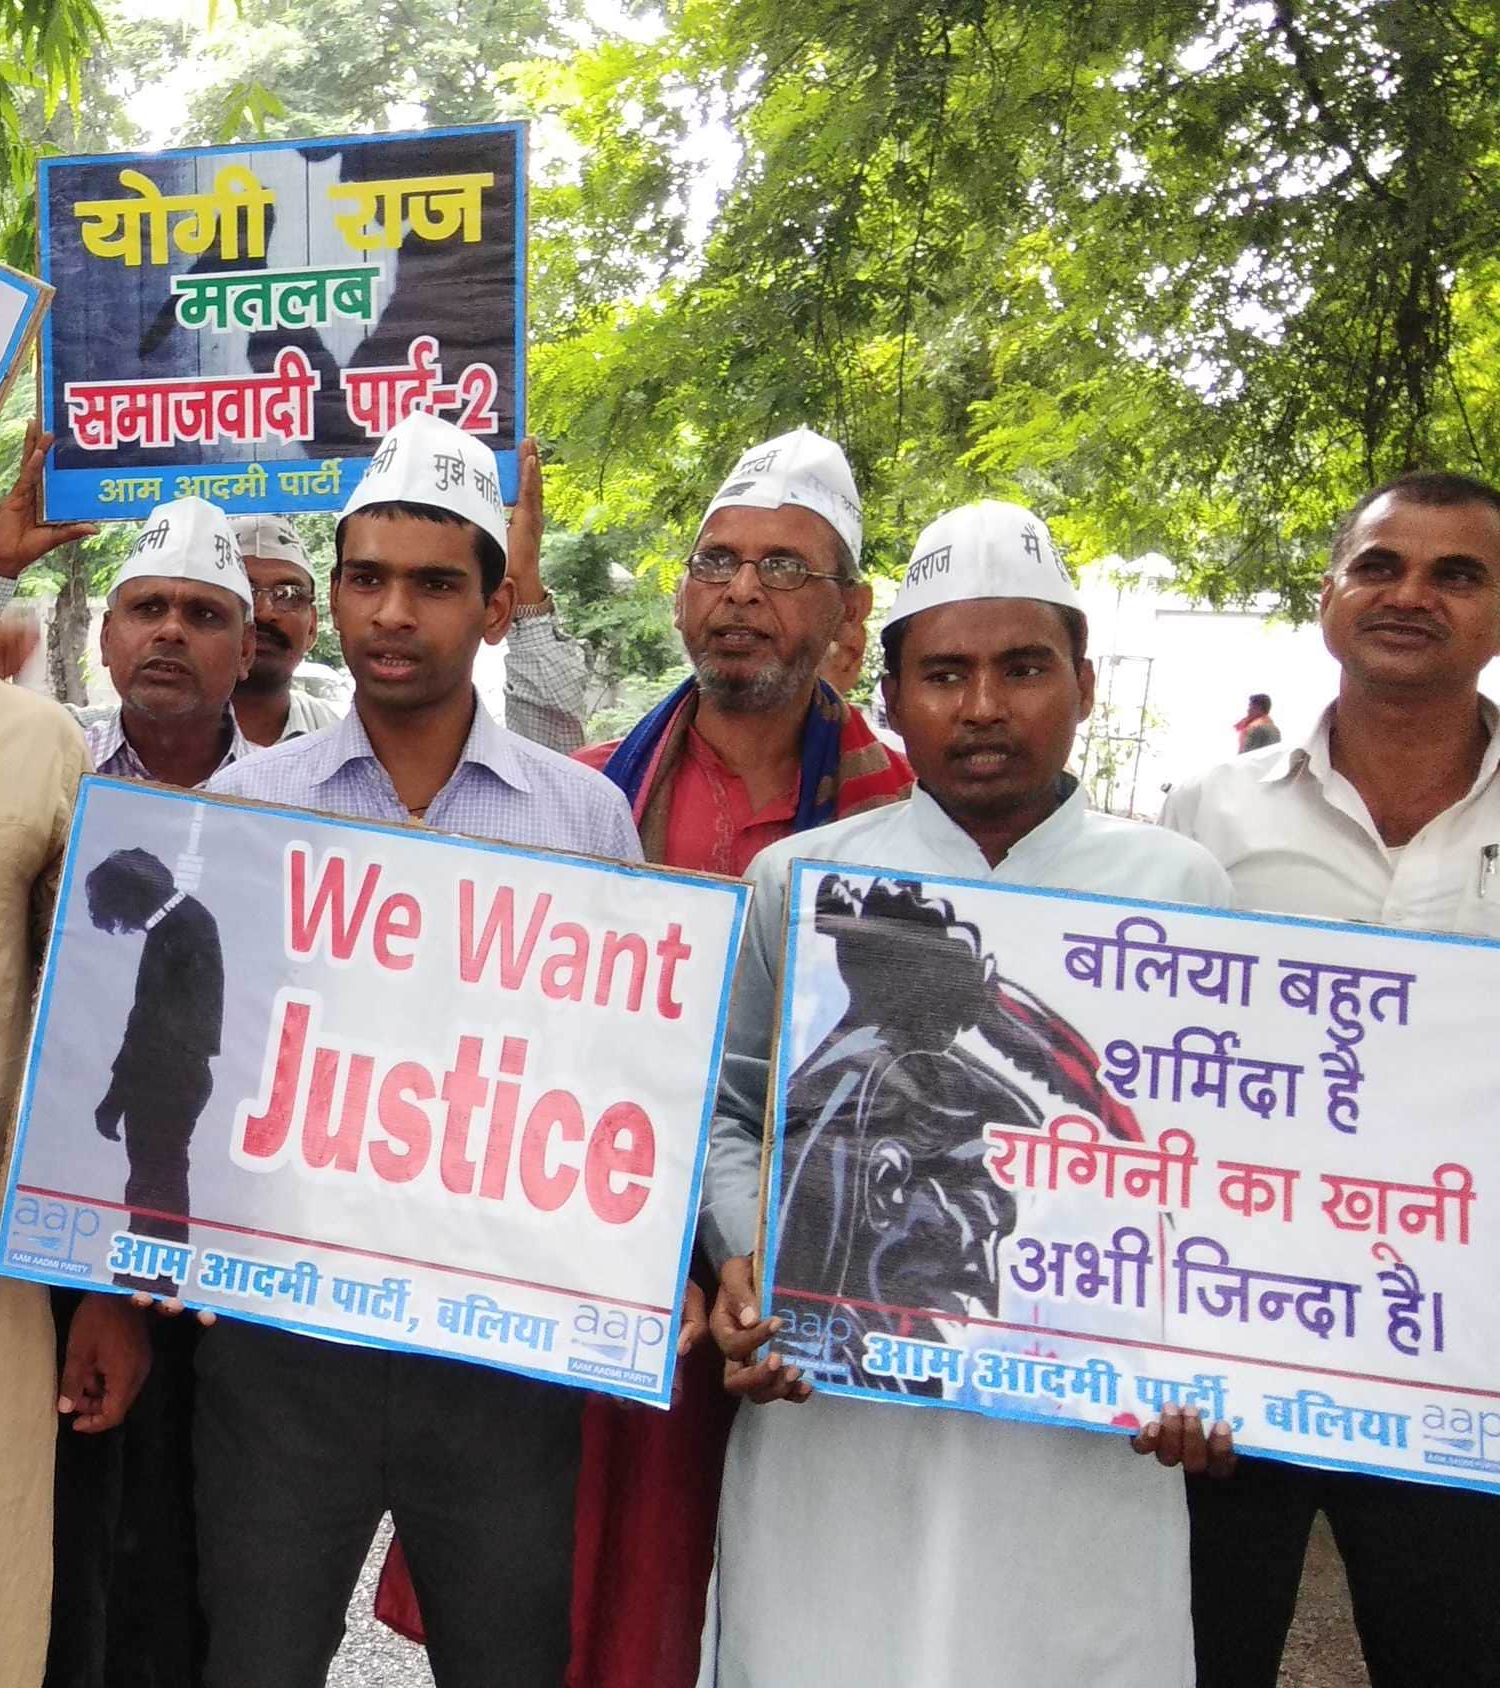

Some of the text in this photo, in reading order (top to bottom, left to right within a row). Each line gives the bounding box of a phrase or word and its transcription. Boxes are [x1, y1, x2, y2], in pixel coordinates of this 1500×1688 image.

[74, 167, 492, 266] योगी राज
[177, 268, 378, 328] मतलब
[70, 352, 314, 445] समाजवादी
[100, 458, 341, 503] आम आदमी पार्टी
[433, 449, 465, 491] मुझे
[907, 545, 952, 588] स्वराज
[292, 852, 693, 1019] We Want
[1064, 918, 1417, 1045] बलिया बहुत
[243, 1003, 655, 1223] Justice
[1319, 1043, 1365, 1134] है
[986, 1114, 1198, 1208] रागिनी
[1219, 1162, 1299, 1221] का
[15, 1198, 99, 1261] aap
[60, 1262, 88, 1274] PARTY
[111, 1237, 560, 1352] आम आदमी पार्टी, बलिया
[1011, 1228, 1150, 1306] अभी
[1174, 1238, 1359, 1338] जिन्दा
[571, 1361, 592, 1372] AAM
[623, 1371, 653, 1384] PARTY
[573, 1304, 664, 1370] aap
[779, 1309, 852, 1362] aap
[869, 1339, 959, 1382] आम
[979, 1354, 1119, 1406] आदमी
[1263, 1389, 1411, 1448] बलिया
[1422, 1404, 1500, 1458] aap
